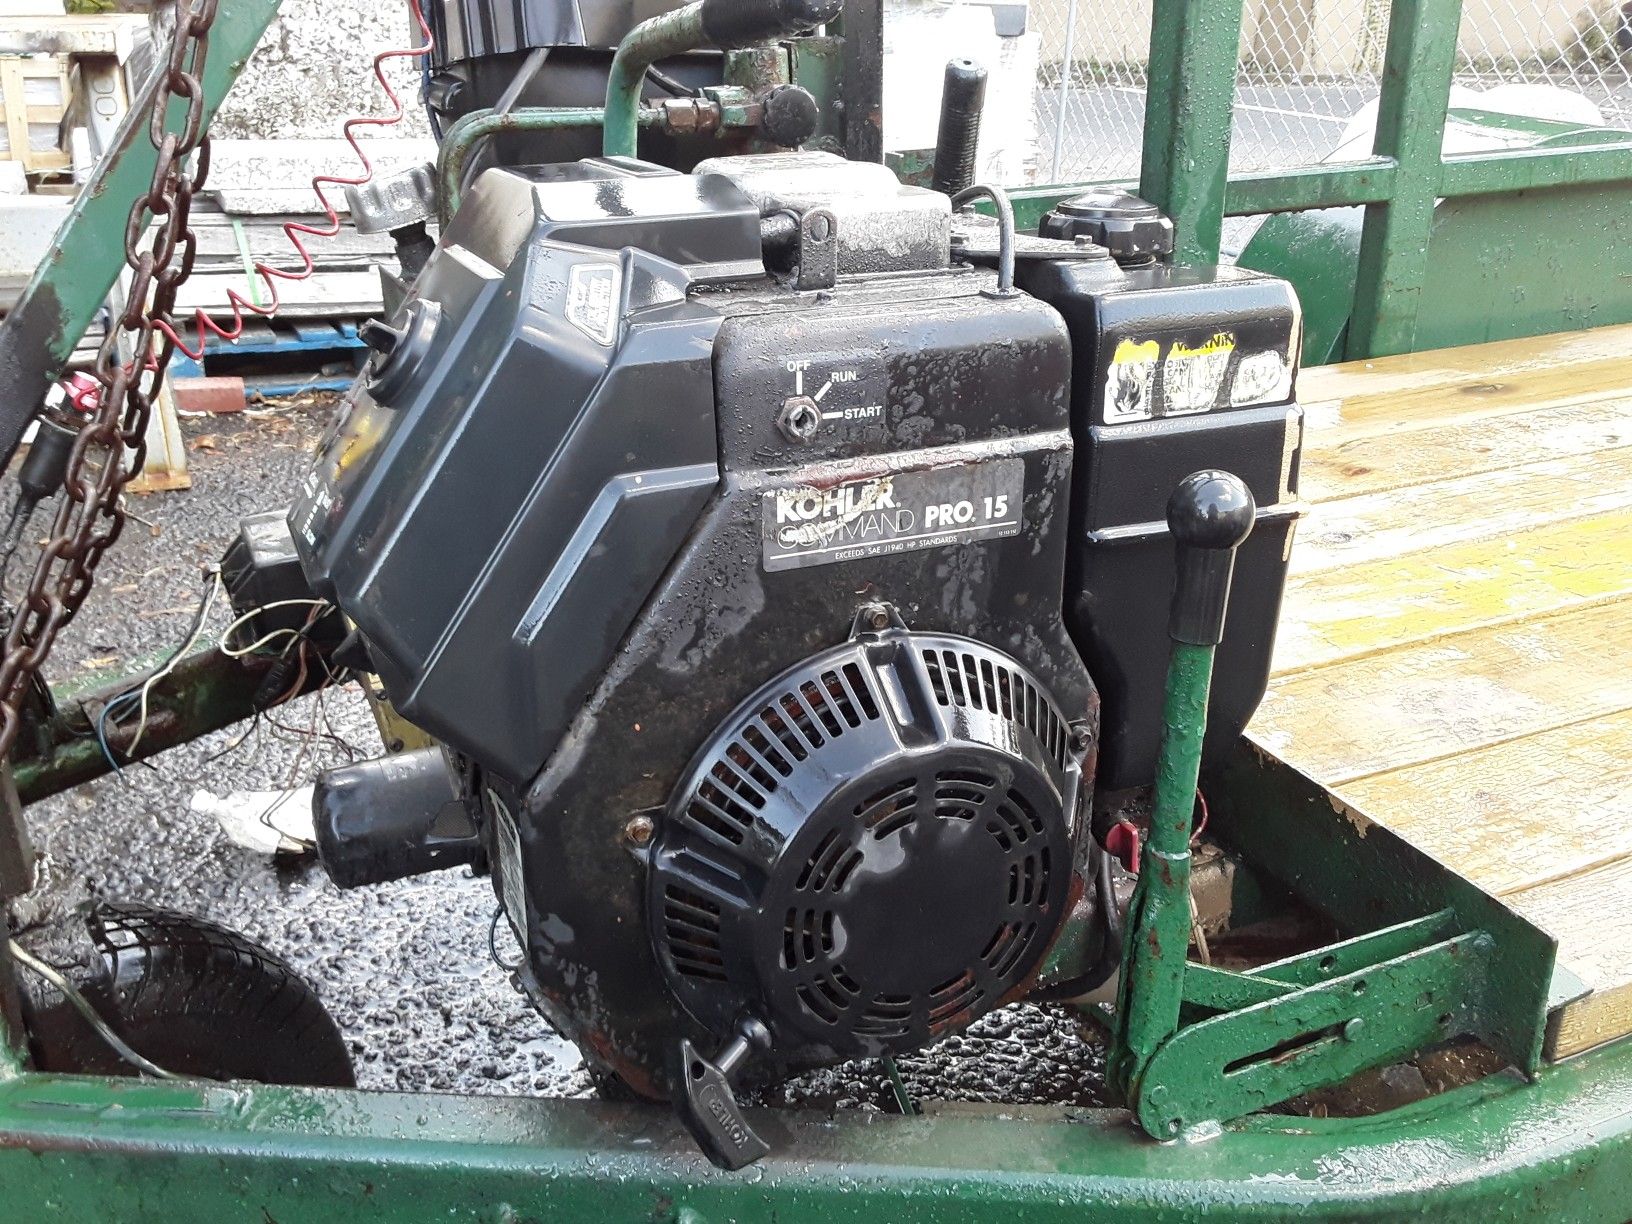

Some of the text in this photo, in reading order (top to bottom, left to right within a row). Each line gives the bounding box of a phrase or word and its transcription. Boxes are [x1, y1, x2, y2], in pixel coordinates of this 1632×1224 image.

[786, 360, 811, 372] OFF
[831, 371, 857, 383] RUN
[844, 405, 882, 419] START
[984, 495, 1008, 520] 15
[835, 548, 865, 560] EXCEEDS
[868, 546, 881, 555] SAE
[884, 543, 904, 553] J1940
[919, 535, 958, 547] STANDARDS
